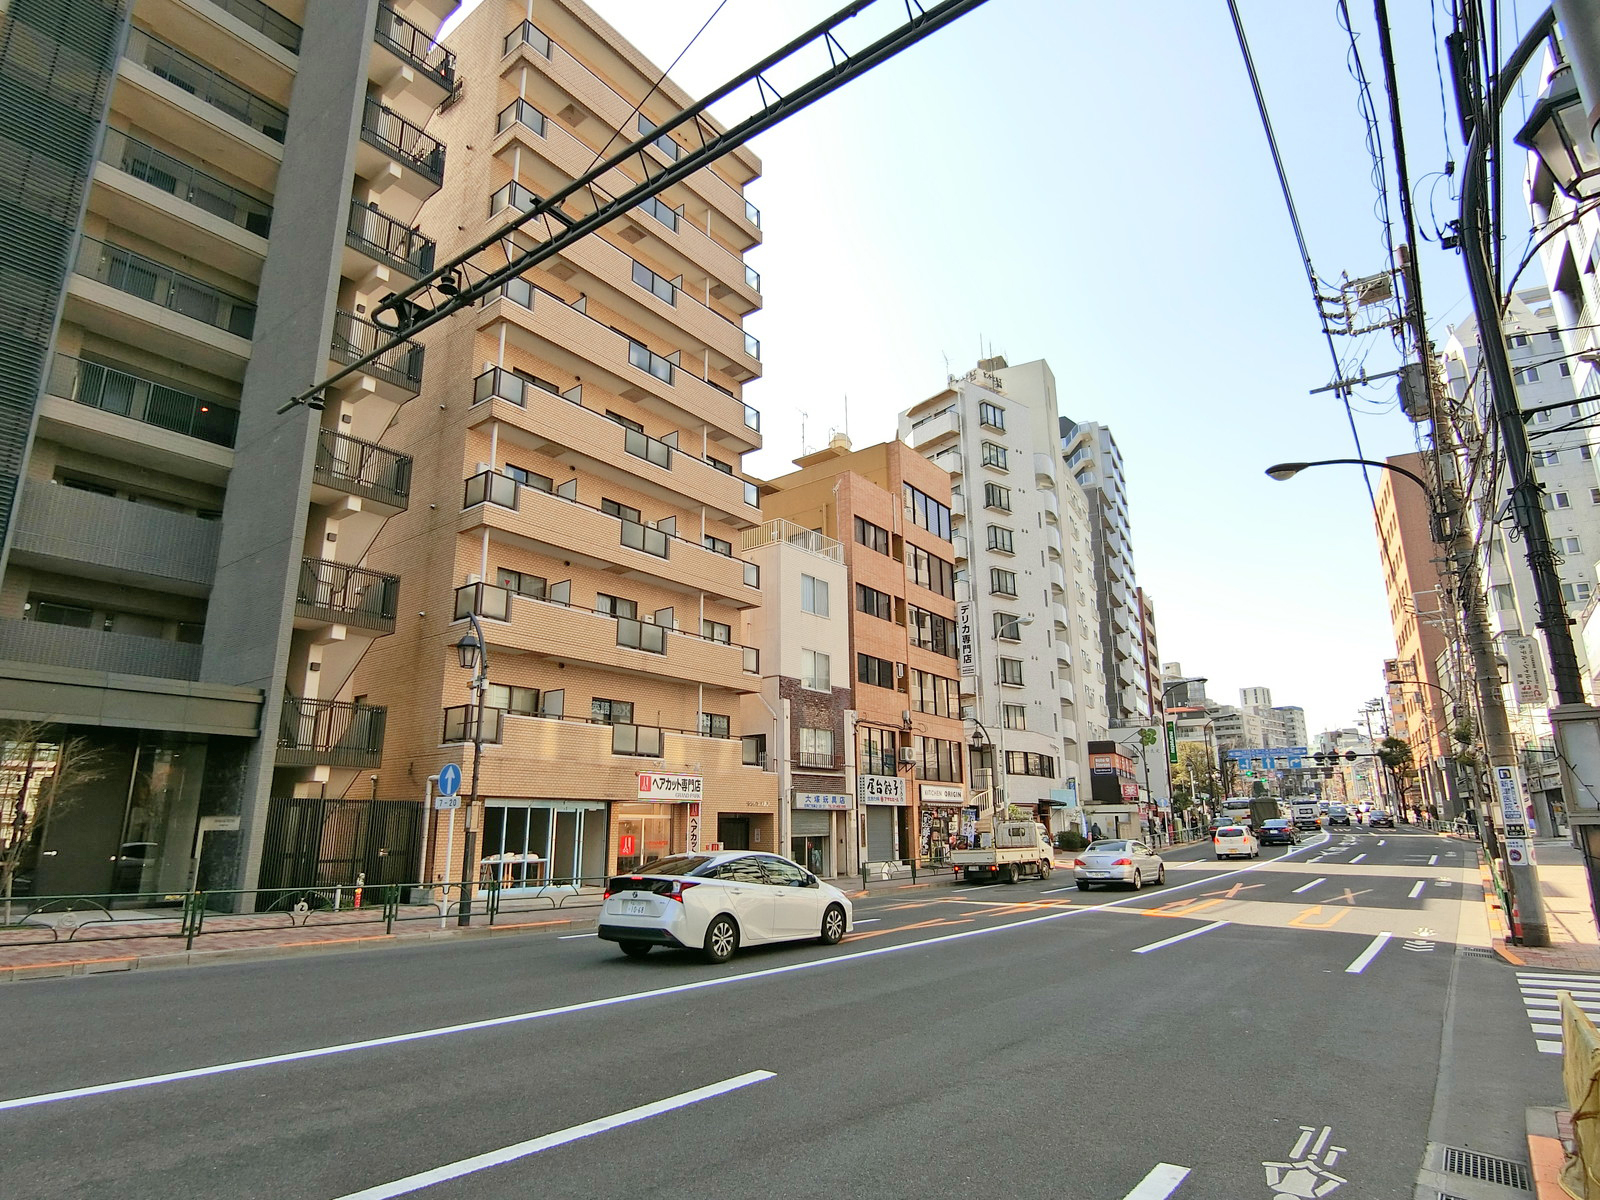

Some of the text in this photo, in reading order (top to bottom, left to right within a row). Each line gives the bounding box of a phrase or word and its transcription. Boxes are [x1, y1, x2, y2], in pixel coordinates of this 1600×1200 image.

[960, 604, 972, 664] デリカ専門店
[1519, 644, 1532, 685] ホテル・シャルム
[592, 700, 610, 715] 英語
[652, 777, 701, 792] ヘアカット専門店
[867, 778, 899, 796] 屋台餃子
[944, 790, 962, 798] ORIGIN
